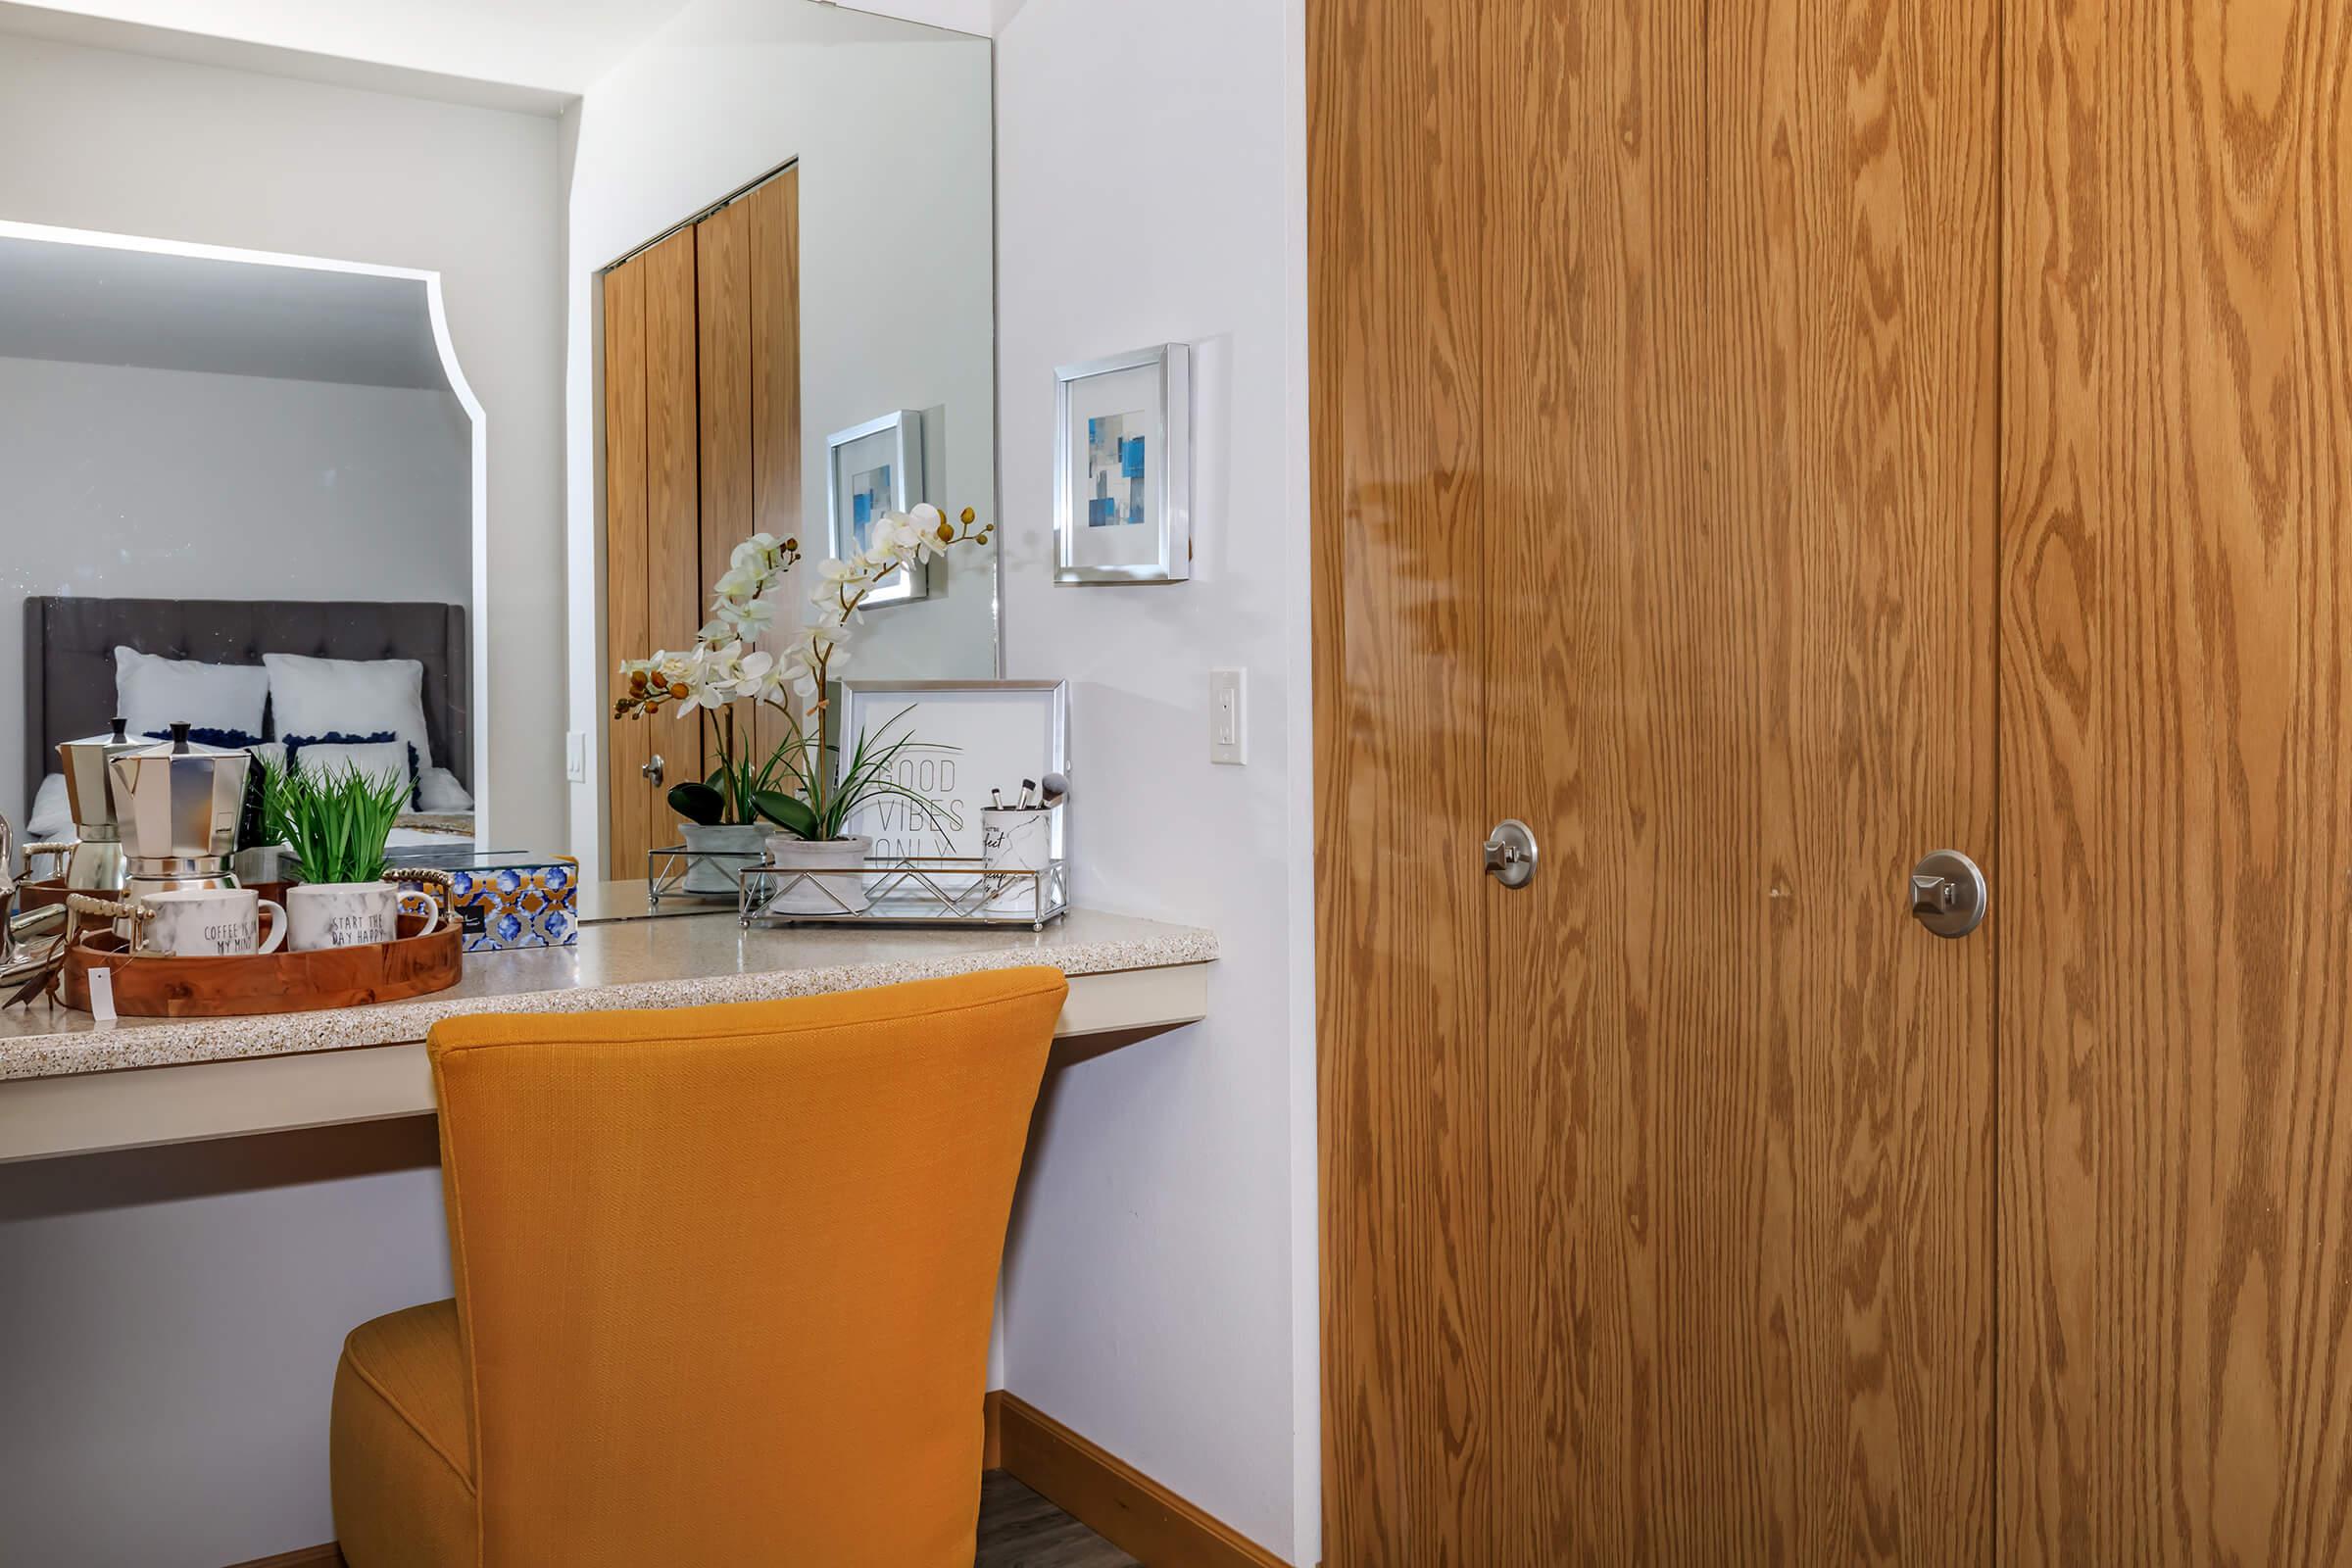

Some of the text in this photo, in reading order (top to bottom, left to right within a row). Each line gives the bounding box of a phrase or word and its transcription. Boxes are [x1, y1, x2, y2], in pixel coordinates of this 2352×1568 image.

[877, 760, 956, 792] GOOD
[877, 799, 964, 832] VIBES
[332, 913, 382, 930] START THE
[204, 923, 238, 941] COFFEE
[332, 928, 384, 945] DAY HAPPY
[218, 940, 230, 956] MY
